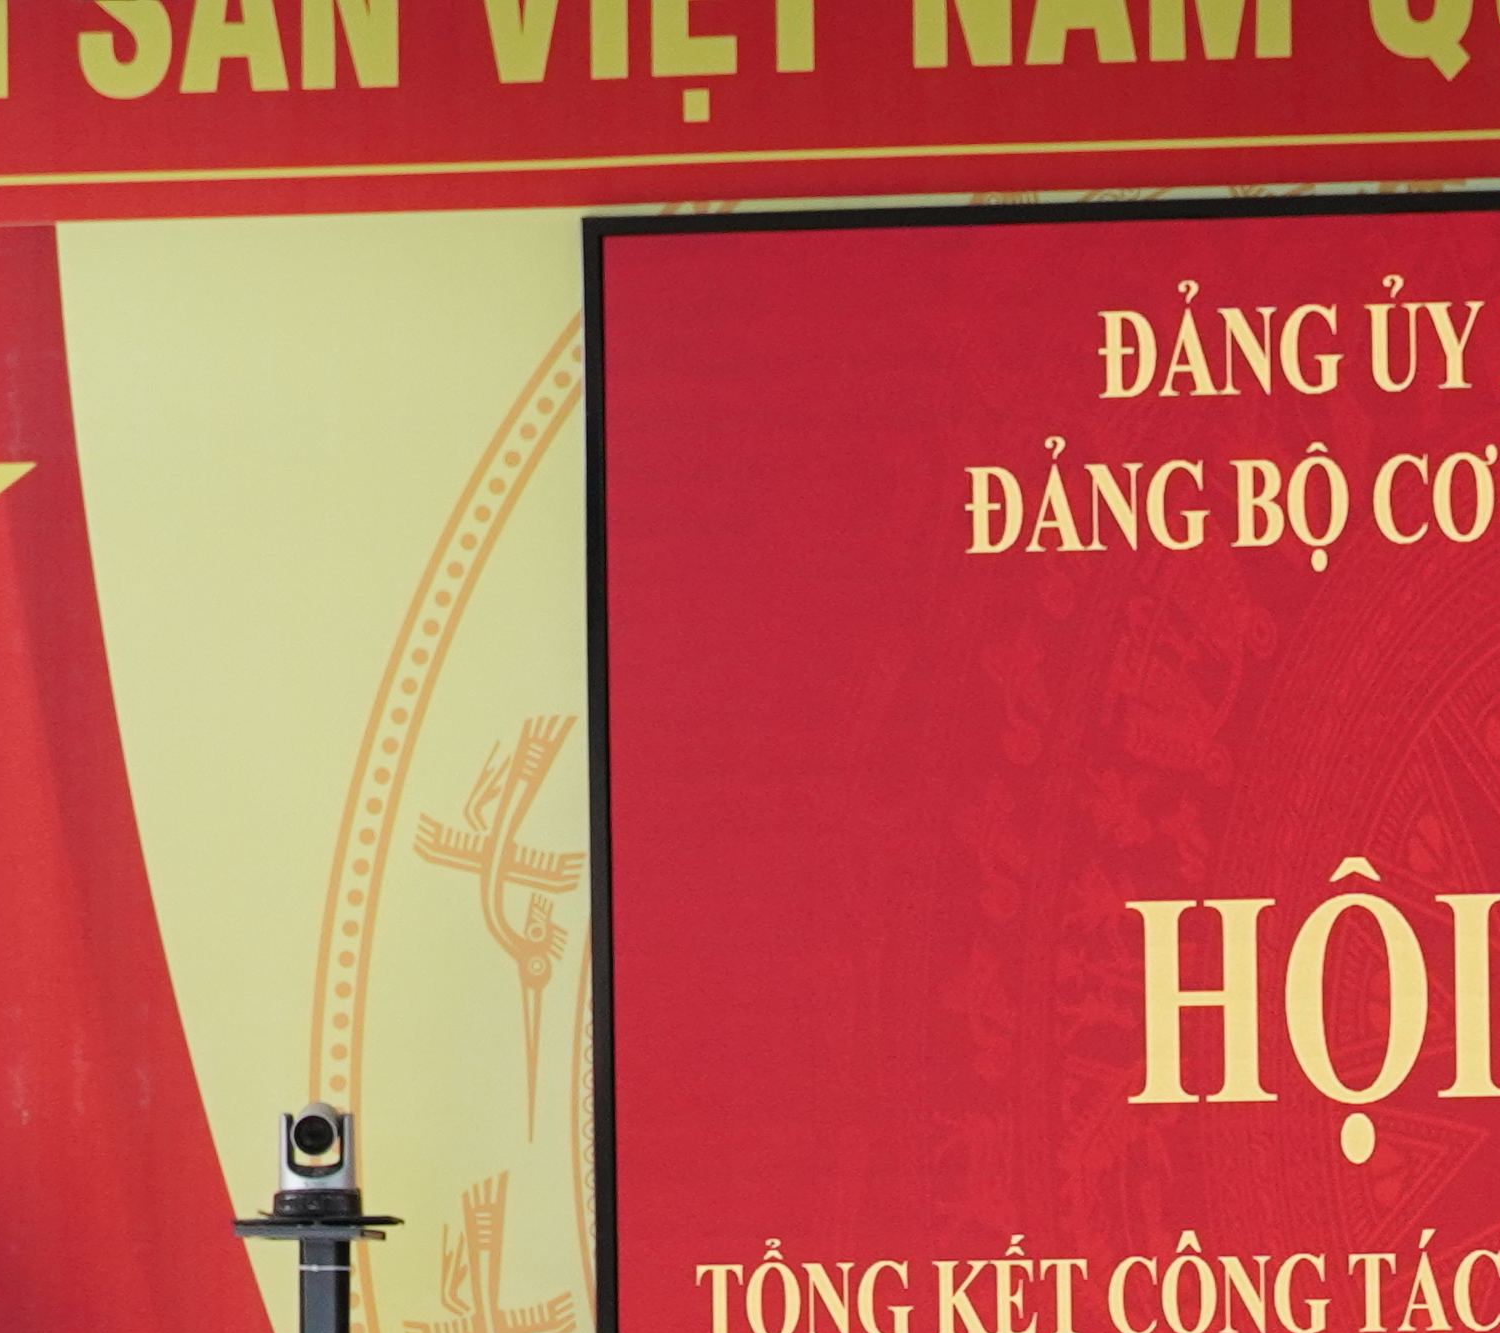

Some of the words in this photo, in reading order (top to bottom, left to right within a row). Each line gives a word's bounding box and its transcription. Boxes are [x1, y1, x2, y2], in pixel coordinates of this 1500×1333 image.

[1097, 279, 1344, 399] ĐẢNG
[1364, 274, 1485, 393] ỦY
[964, 435, 1211, 554] ĐẢNG
[1229, 441, 1349, 573] BỘ
[1372, 443, 1498, 545] CƠ
